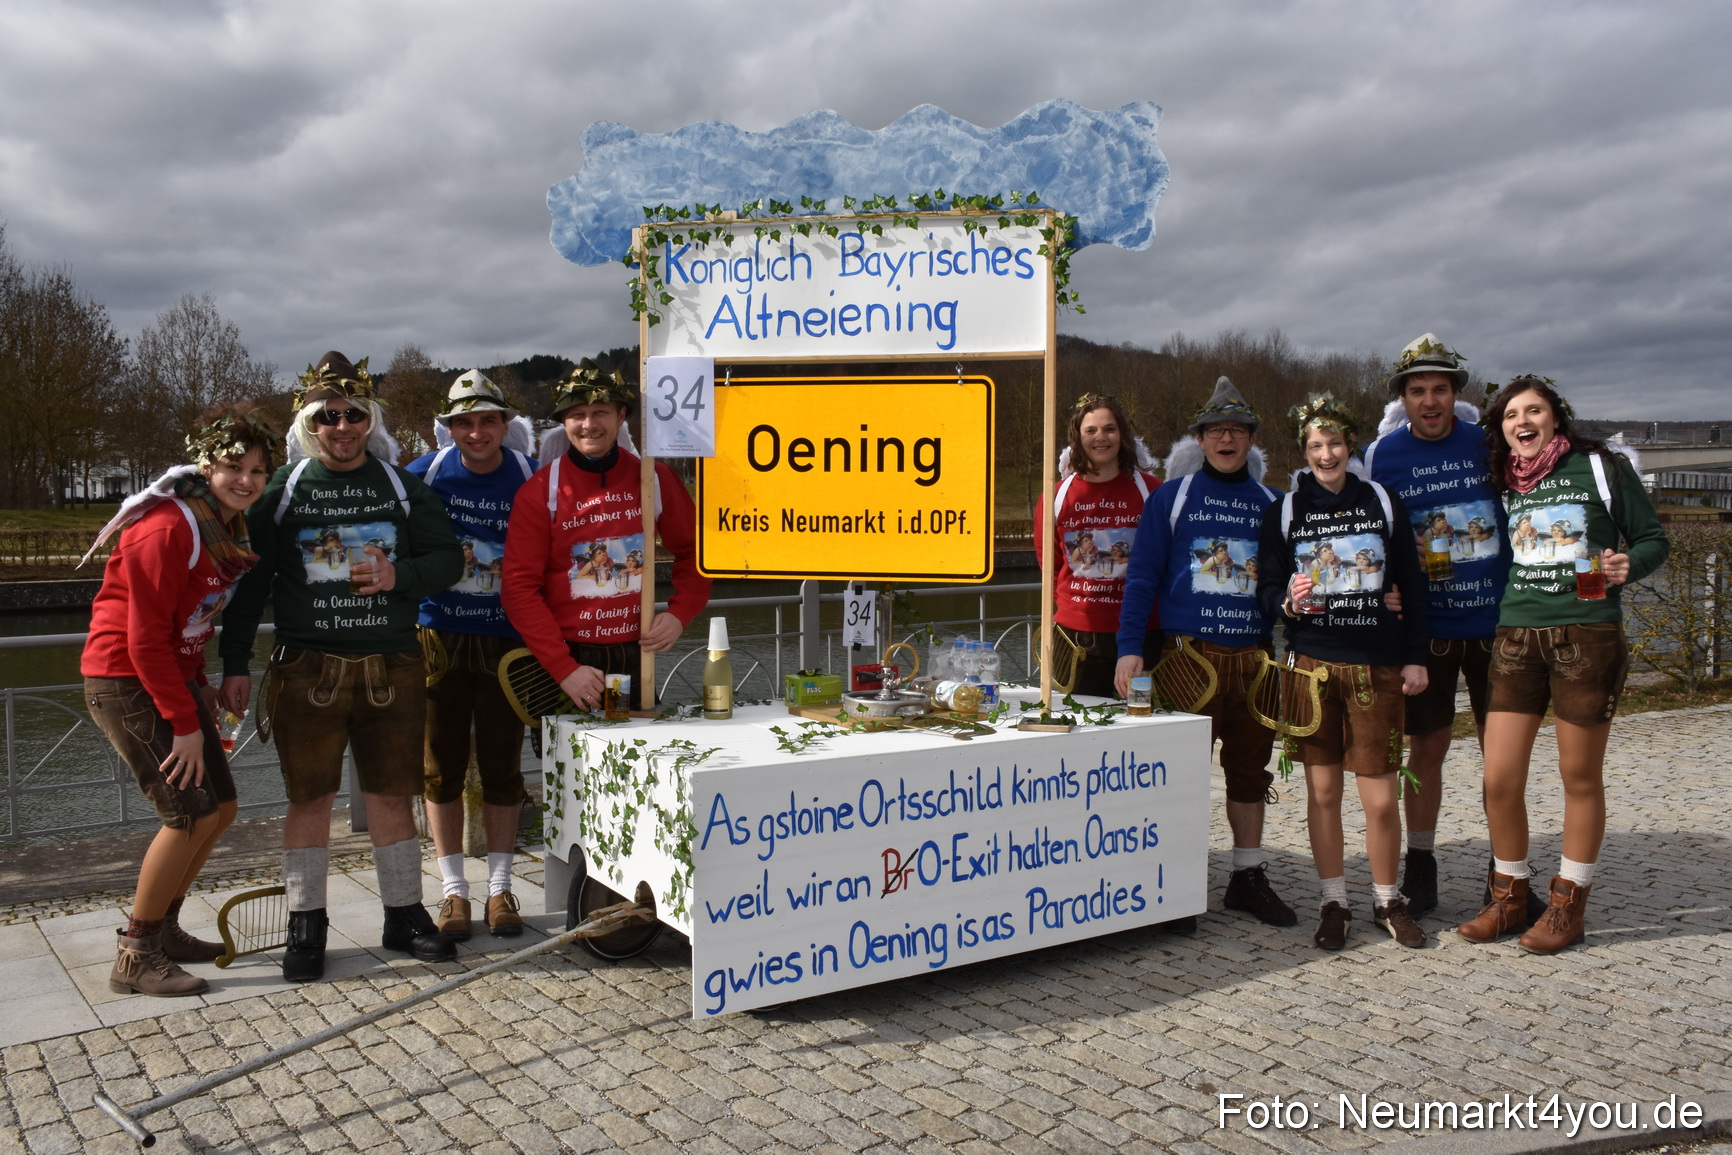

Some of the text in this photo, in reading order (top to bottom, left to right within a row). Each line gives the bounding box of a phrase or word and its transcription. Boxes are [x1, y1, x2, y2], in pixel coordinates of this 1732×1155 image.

[665, 232, 1034, 294] Königlich Bayrisches
[705, 285, 958, 350] Altneiening
[653, 375, 705, 421] 34
[748, 424, 941, 486] Oening
[1412, 459, 1474, 478] Oans des is
[1399, 485, 1424, 499] scho
[1427, 480, 1459, 492] immer
[1540, 478, 1571, 490] des is
[312, 485, 377, 500] Oans des is
[450, 494, 510, 511] Oans des is
[576, 491, 633, 510] Oans des is
[1074, 498, 1127, 511] Oans des is
[1204, 495, 1260, 512] Oans des is
[294, 503, 320, 515] scho
[323, 507, 359, 516] immer
[1188, 510, 1212, 521] scho
[1216, 513, 1245, 524] immer
[1306, 512, 1330, 522] Oans
[1356, 507, 1366, 516] is
[461, 513, 493, 526] immer
[562, 516, 586, 530] scho
[590, 511, 621, 523] immer
[718, 507, 971, 534] Kreis Neumarkt i.d.OPf.
[1082, 516, 1111, 524] immer
[1292, 520, 1383, 538] scho immer gwieß
[1562, 568, 1573, 576] is
[1070, 581, 1081, 590] in
[1083, 581, 1114, 593] Oening
[1444, 580, 1481, 592] Oening
[1483, 578, 1492, 587] is
[314, 594, 388, 609] in Oening is
[1329, 598, 1365, 610] Oening
[1368, 597, 1378, 607] is
[1447, 595, 1496, 608] Paradies
[455, 606, 492, 616] Oening
[580, 604, 640, 620] in Oening is
[847, 600, 871, 626] 34
[1201, 607, 1214, 617] in
[1217, 606, 1253, 621] Oening
[315, 614, 388, 629] as Paradies
[1312, 614, 1377, 626] as Paradies
[578, 622, 638, 638] as Paradies
[701, 750, 1166, 861] As gstoine Ortsschild kinnts pfalten
[706, 869, 774, 923] weil
[787, 872, 832, 910] wir
[836, 875, 870, 902] an
[1008, 826, 1081, 872] halten.
[1085, 814, 1138, 859] Oans
[1143, 817, 1159, 850] is
[704, 951, 803, 1015] gwies
[811, 943, 838, 976] in
[849, 920, 947, 969] Oening
[956, 913, 979, 949] is
[982, 912, 1015, 942] as
[1025, 878, 1146, 934] Paradies
